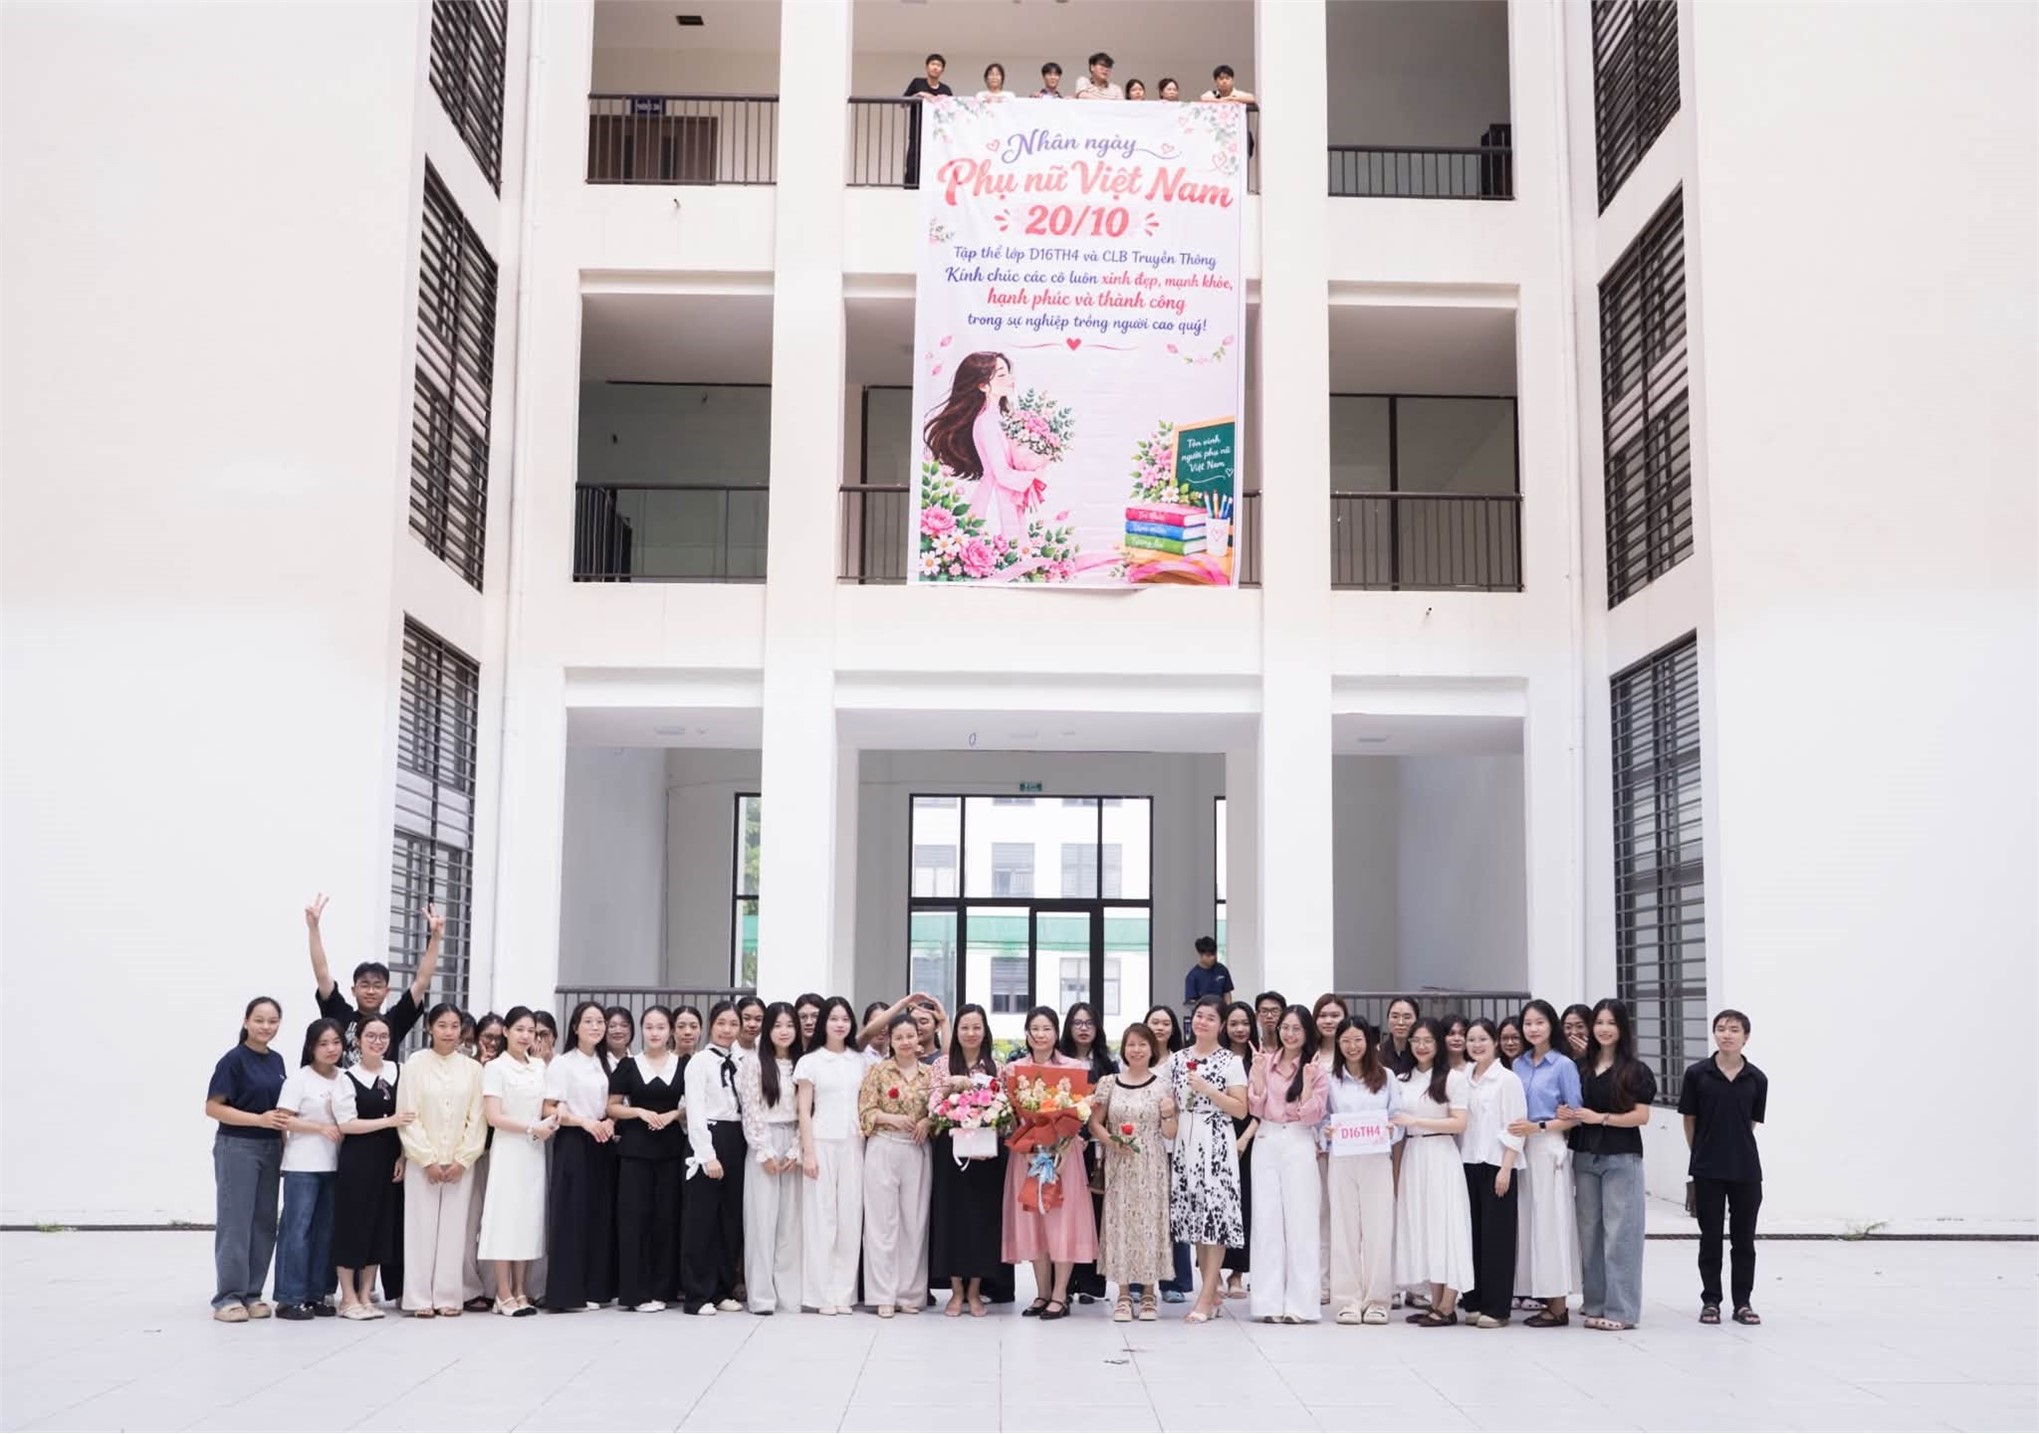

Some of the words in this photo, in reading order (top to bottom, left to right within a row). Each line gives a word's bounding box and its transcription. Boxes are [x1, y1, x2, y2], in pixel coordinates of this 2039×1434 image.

[1001, 128, 1080, 164] Nhân
[1085, 134, 1140, 159] ngày
[937, 157, 1018, 206] Phụ
[1023, 165, 1068, 192] nữ
[1071, 160, 1142, 200] Việt
[1145, 166, 1233, 208] Nam
[1025, 204, 1130, 237] 20/10
[954, 246, 977, 262] Tập
[981, 244, 1002, 260] thể
[1006, 246, 1025, 263] lớp
[1030, 247, 1079, 261] D16TH4
[1084, 250, 1098, 262] và
[1102, 250, 1128, 263] CLB
[1132, 249, 1175, 269] Truyền
[1180, 252, 1216, 271] Thông
[946, 266, 984, 283] Kính
[987, 267, 1020, 283] chúc
[1024, 270, 1047, 284] các
[1051, 272, 1065, 284] cô
[1069, 270, 1098, 284] luôn
[1102, 270, 1131, 285] xinh
[1135, 271, 1161, 290] đẹp,
[1165, 274, 1199, 290] mạnh
[987, 286, 1028, 307] hạnh
[1031, 288, 1070, 311] phúc
[1075, 292, 1094, 307] và
[1098, 290, 1144, 308] thành
[1149, 295, 1185, 316] công
[968, 313, 1002, 331] trong
[1007, 316, 1022, 329] sự
[1025, 313, 1069, 332] nghiệp
[1074, 314, 1108, 333] trồng
[1113, 317, 1149, 334] người
[1152, 320, 1174, 330] cao
[1178, 318, 1207, 336] quý!
[1207, 460, 1225, 470] Nam
[1341, 1125, 1380, 1139] D16TH4
